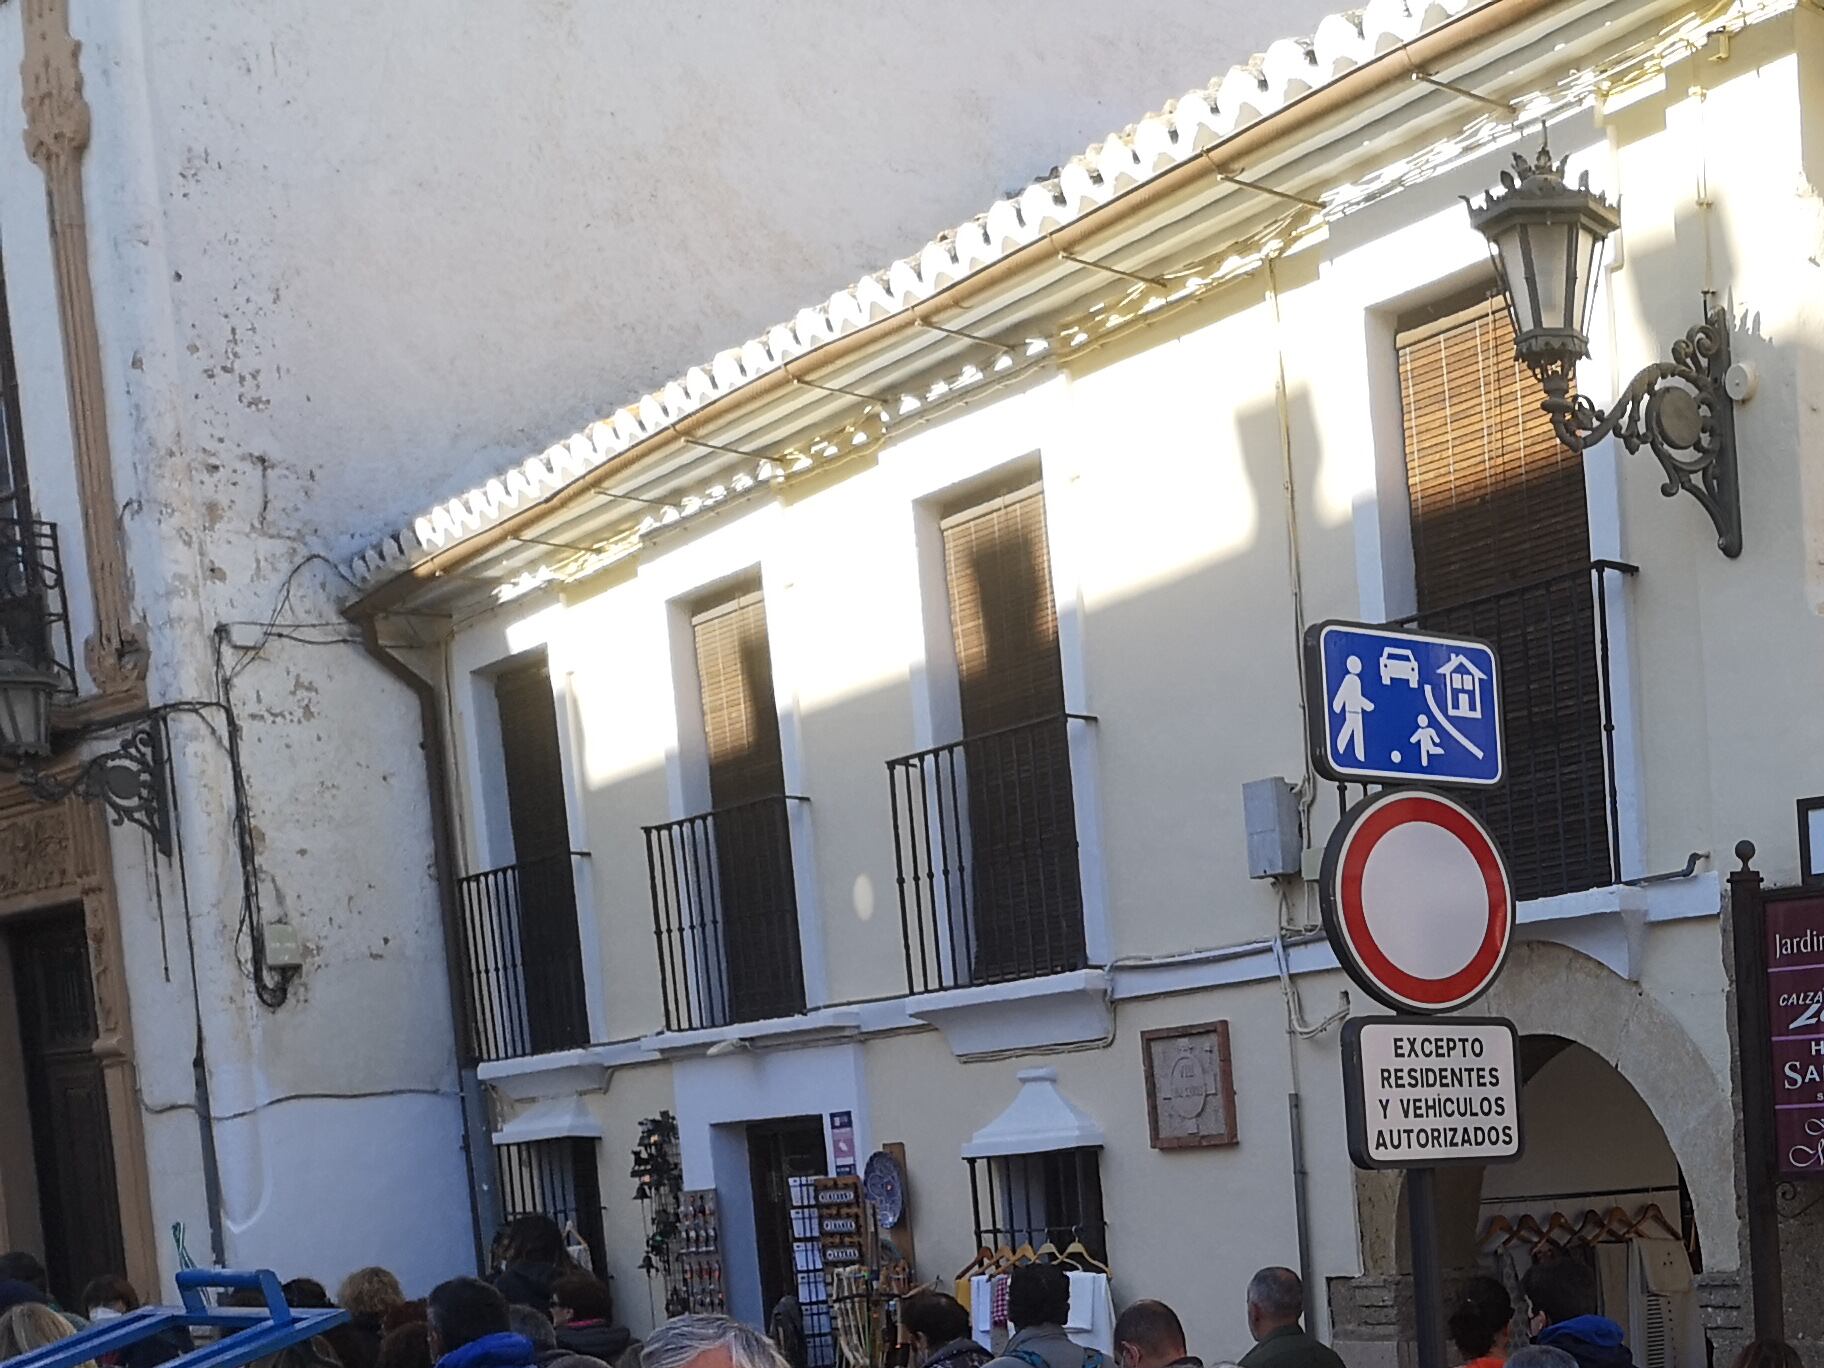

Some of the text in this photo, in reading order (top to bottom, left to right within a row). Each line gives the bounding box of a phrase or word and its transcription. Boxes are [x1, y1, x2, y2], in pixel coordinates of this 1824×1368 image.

[1393, 1037, 1484, 1058] EXCEPTO
[1380, 1067, 1500, 1089] RESIDENTES
[1378, 1093, 1506, 1119] Y VEHÍCULOS
[1375, 1126, 1513, 1151] AUTORIZADOS
